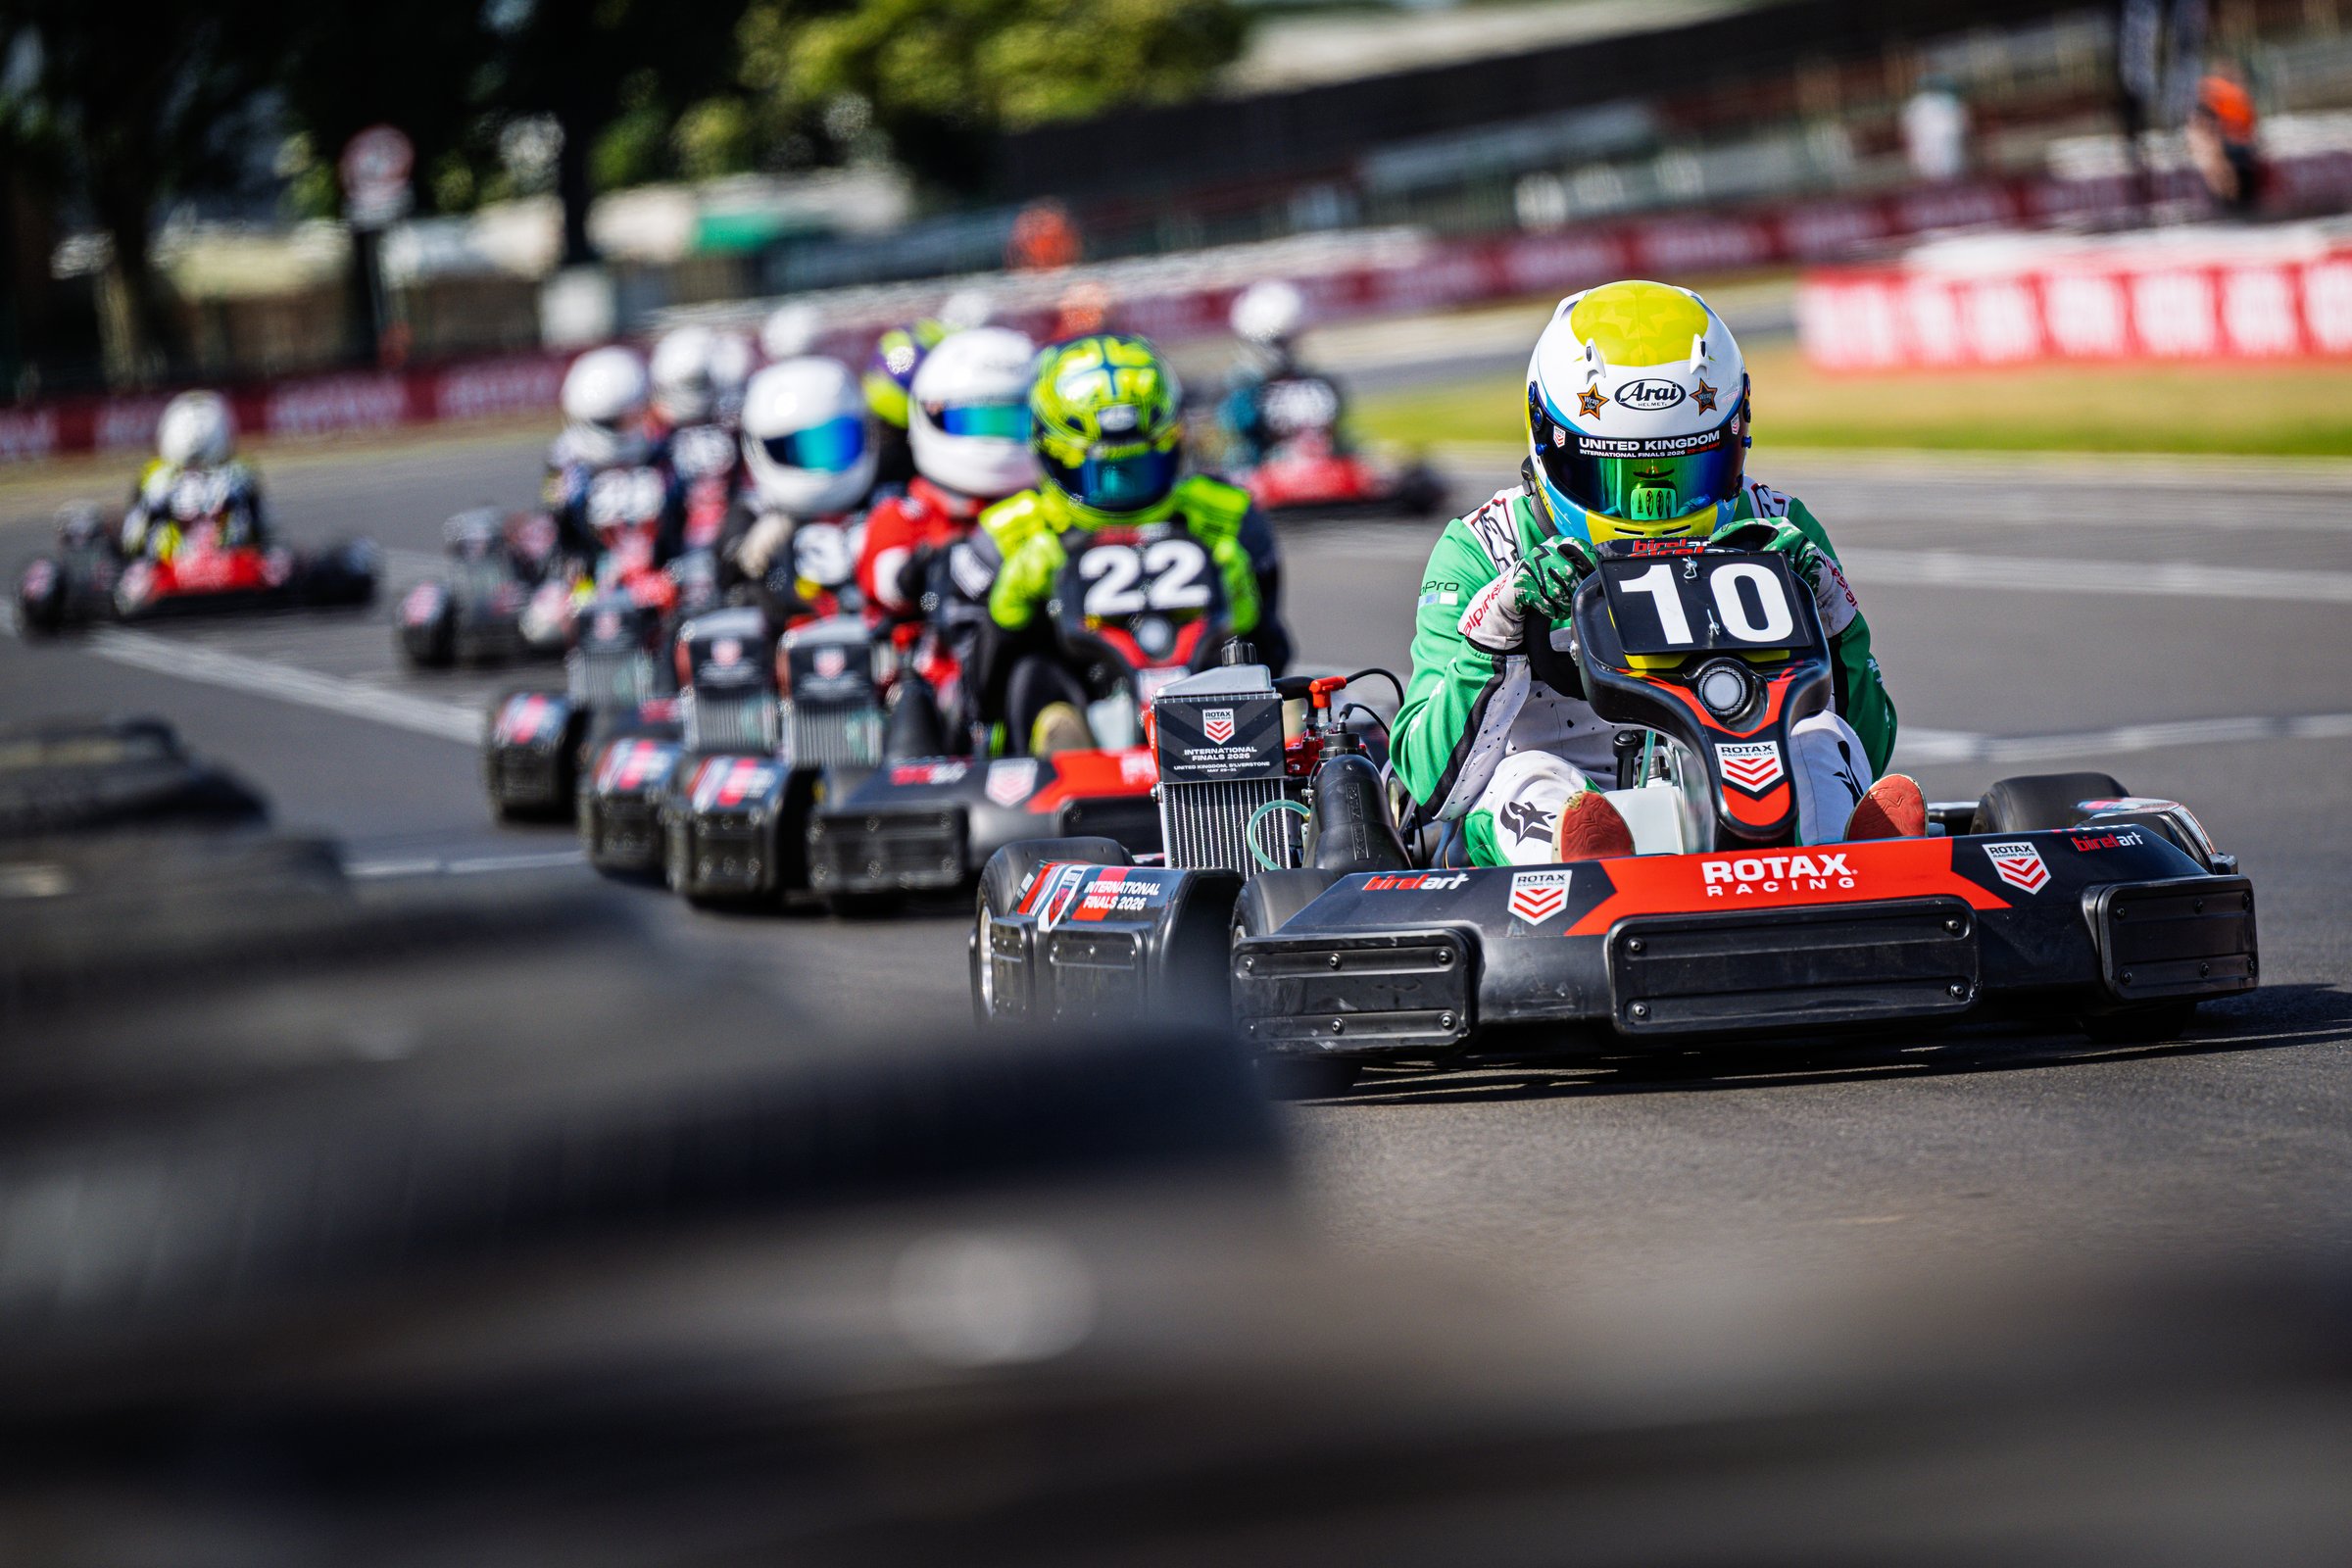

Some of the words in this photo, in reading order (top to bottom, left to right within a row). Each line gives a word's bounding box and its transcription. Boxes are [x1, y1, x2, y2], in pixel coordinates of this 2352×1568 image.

[1584, 396, 1600, 405] Wrap
[1620, 381, 1679, 403] Arai
[1579, 437, 1640, 451] UNITED
[1644, 430, 1720, 451] KINGDOM
[1579, 449, 1637, 458] INTERNATIONAL
[1079, 539, 1210, 616] 22
[1619, 563, 1793, 645] 10
[1184, 747, 1257, 756] INTERNATIONAL
[1988, 845, 2034, 855] ROTAX
[2071, 832, 2143, 852] birelart
[1517, 873, 1566, 883] ROTAX
[1701, 854, 1852, 885] ROTAX
[1084, 881, 1160, 895] INTERNATIONAL
[1361, 873, 1470, 891] birelart
[1706, 877, 1855, 898] RACING
[1082, 896, 1118, 909] FINALS
[1116, 896, 1148, 911] 2026
